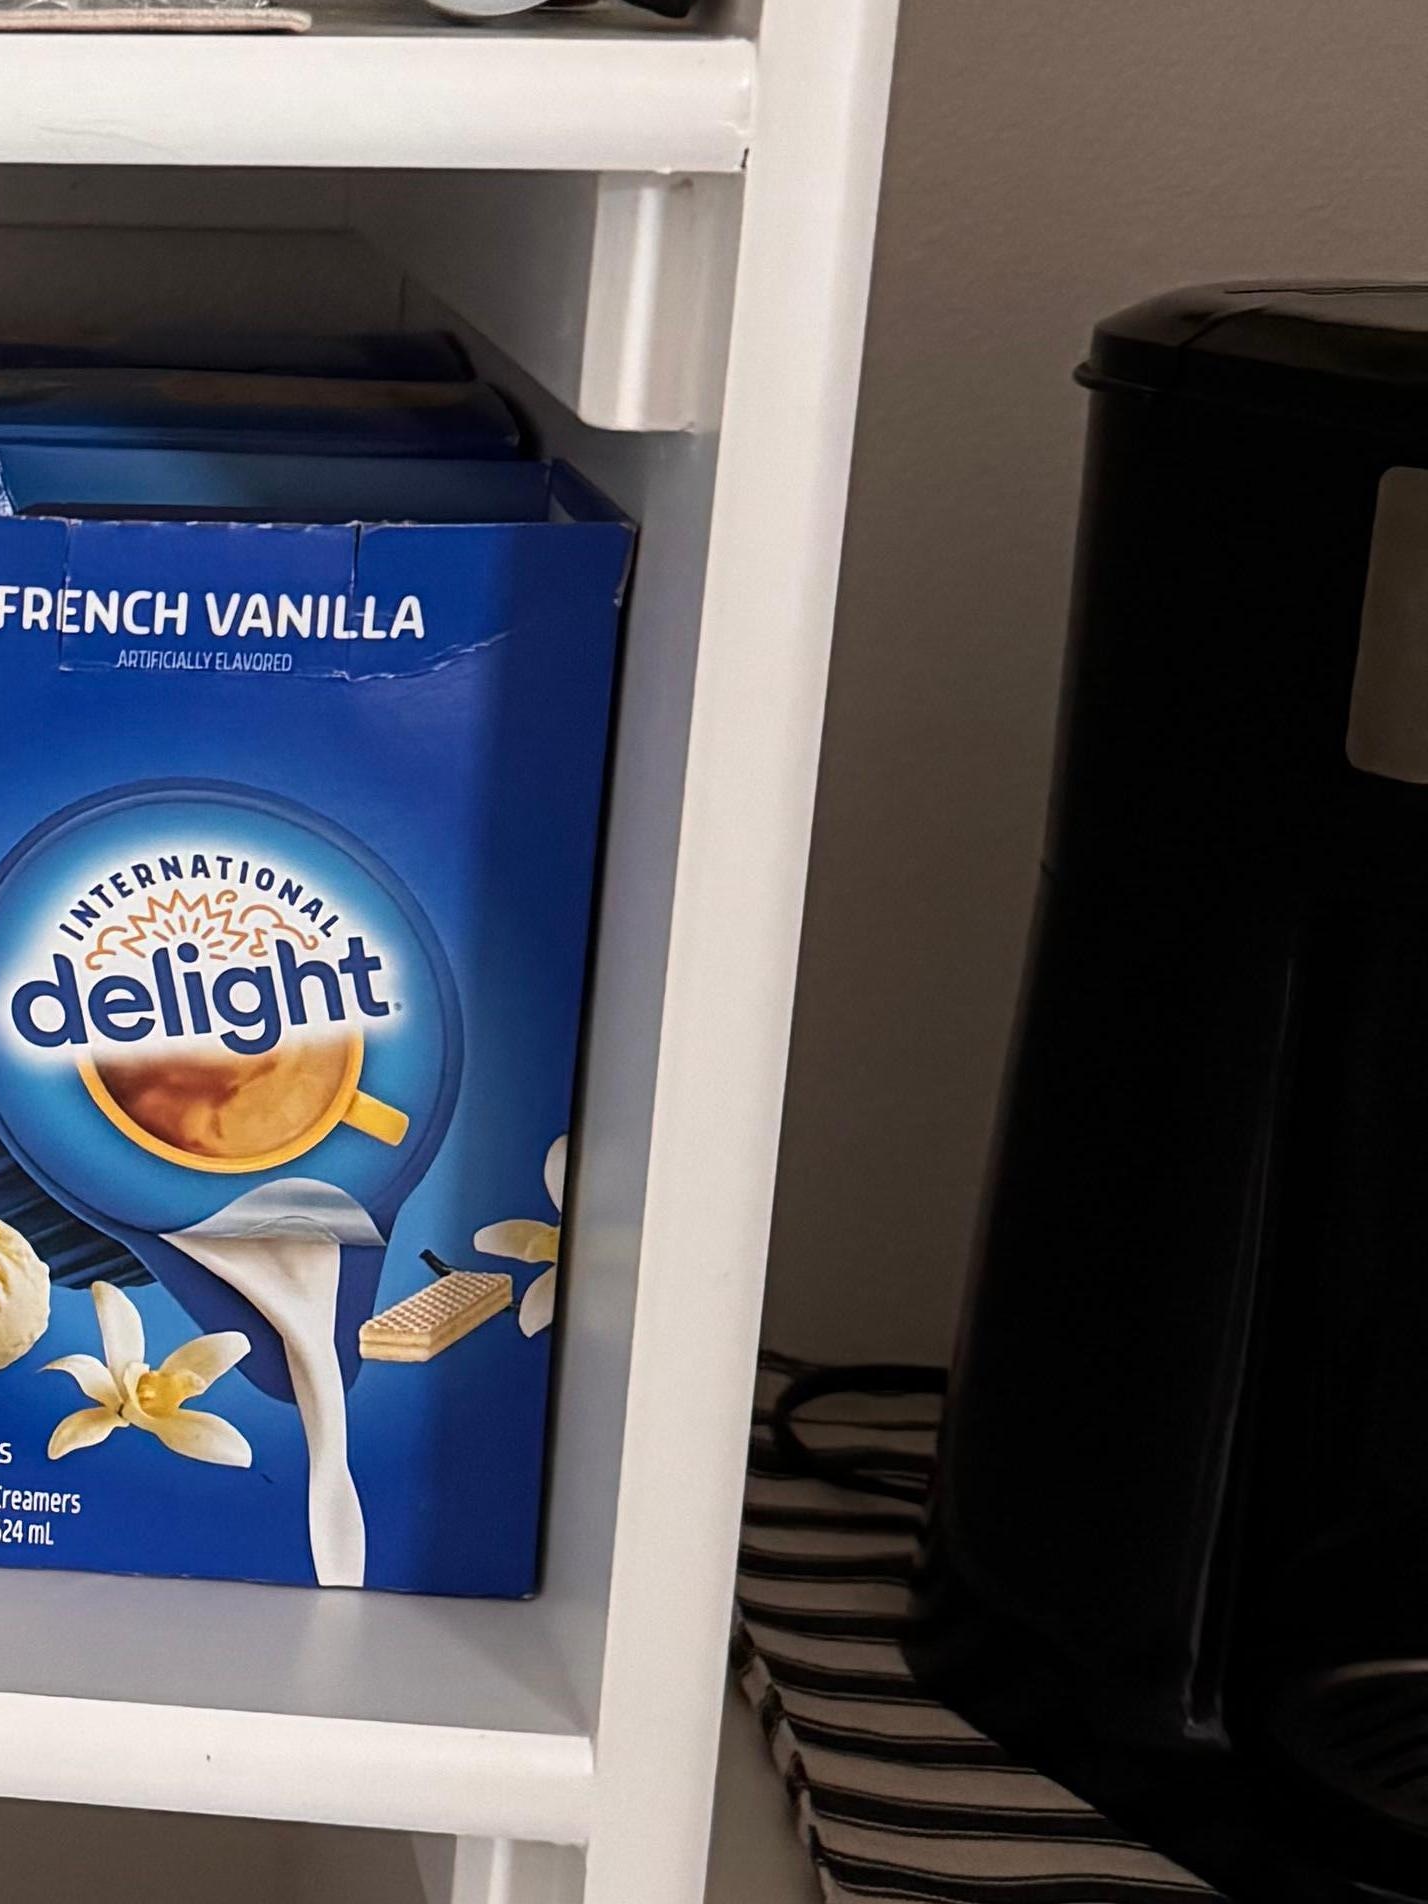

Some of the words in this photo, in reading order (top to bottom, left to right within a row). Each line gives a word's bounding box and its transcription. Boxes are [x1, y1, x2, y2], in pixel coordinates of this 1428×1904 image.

[205, 592, 425, 640] VANILLA
[115, 649, 212, 670] ARTIFICIALLY
[59, 853, 341, 941] INTERNATIONAL
[11, 936, 390, 1055] delight
[28, 1520, 54, 1546] mL
